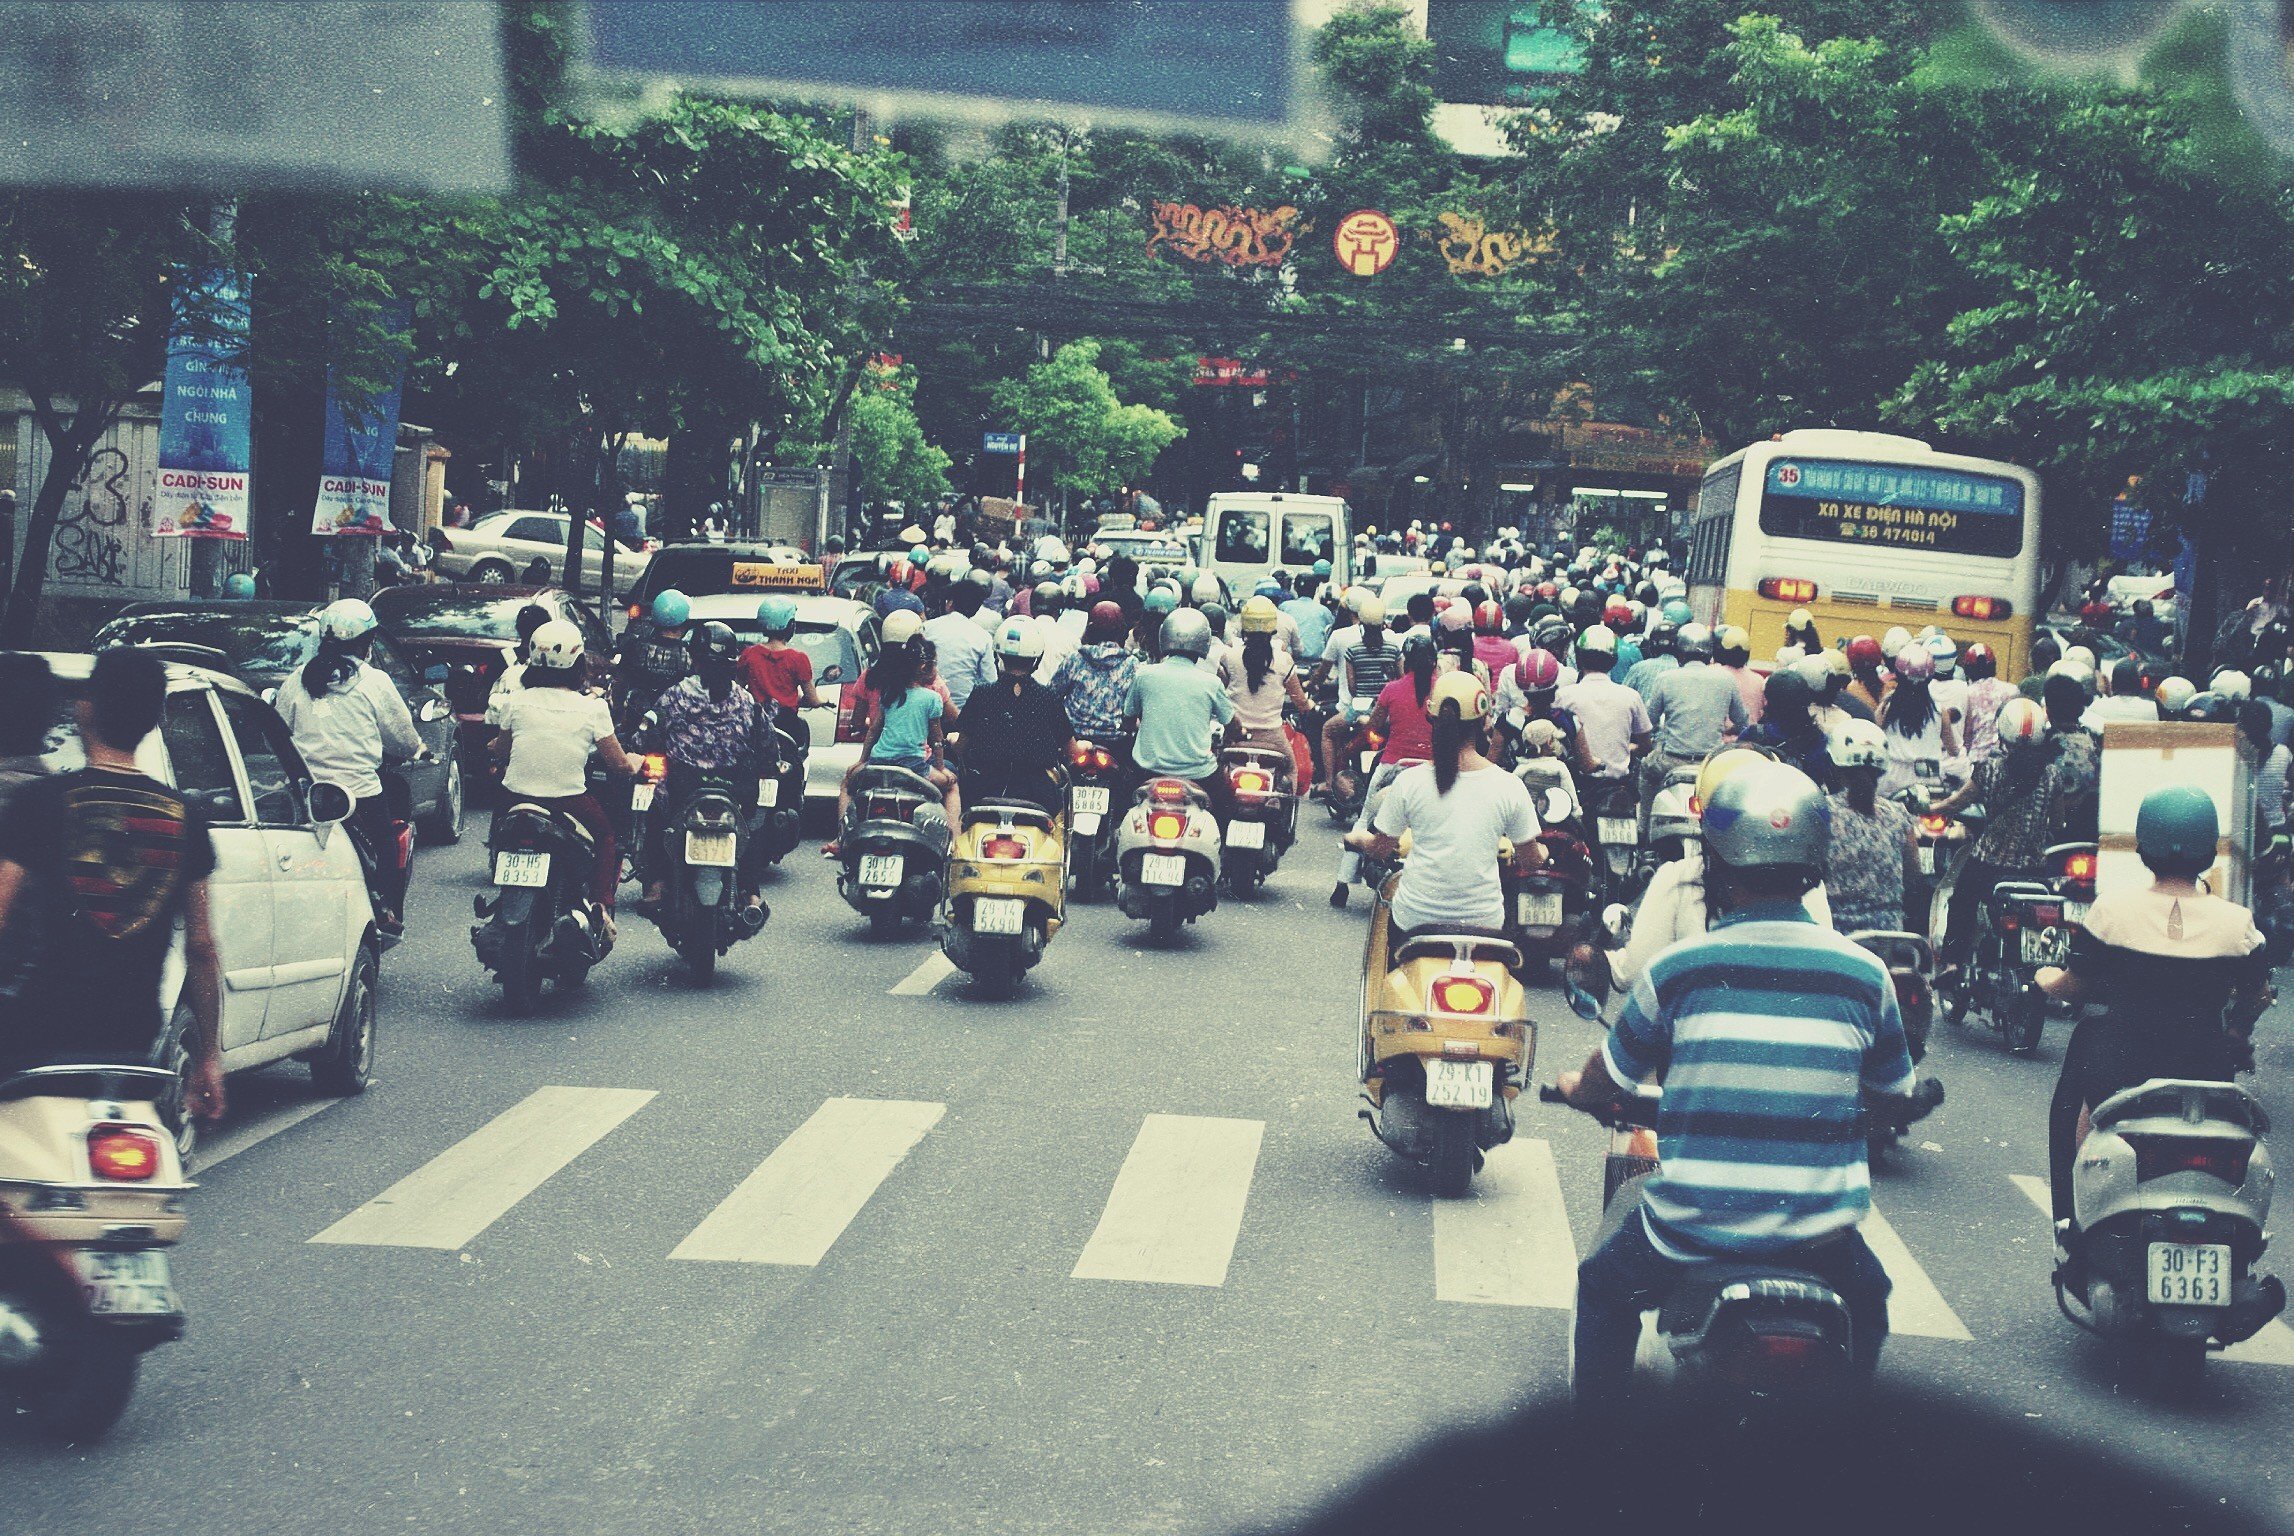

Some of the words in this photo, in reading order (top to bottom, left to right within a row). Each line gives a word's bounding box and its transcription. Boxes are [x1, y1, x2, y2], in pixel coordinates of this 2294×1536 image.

[185, 410, 227, 424] CHUNG
[162, 473, 243, 491] CADI-SUN
[1779, 467, 1799, 484] 35
[1843, 504, 1862, 520] XE
[503, 869, 539, 883] 8353
[2161, 1248, 2219, 1273] 30-F3
[2161, 1275, 2219, 1300] 6363
